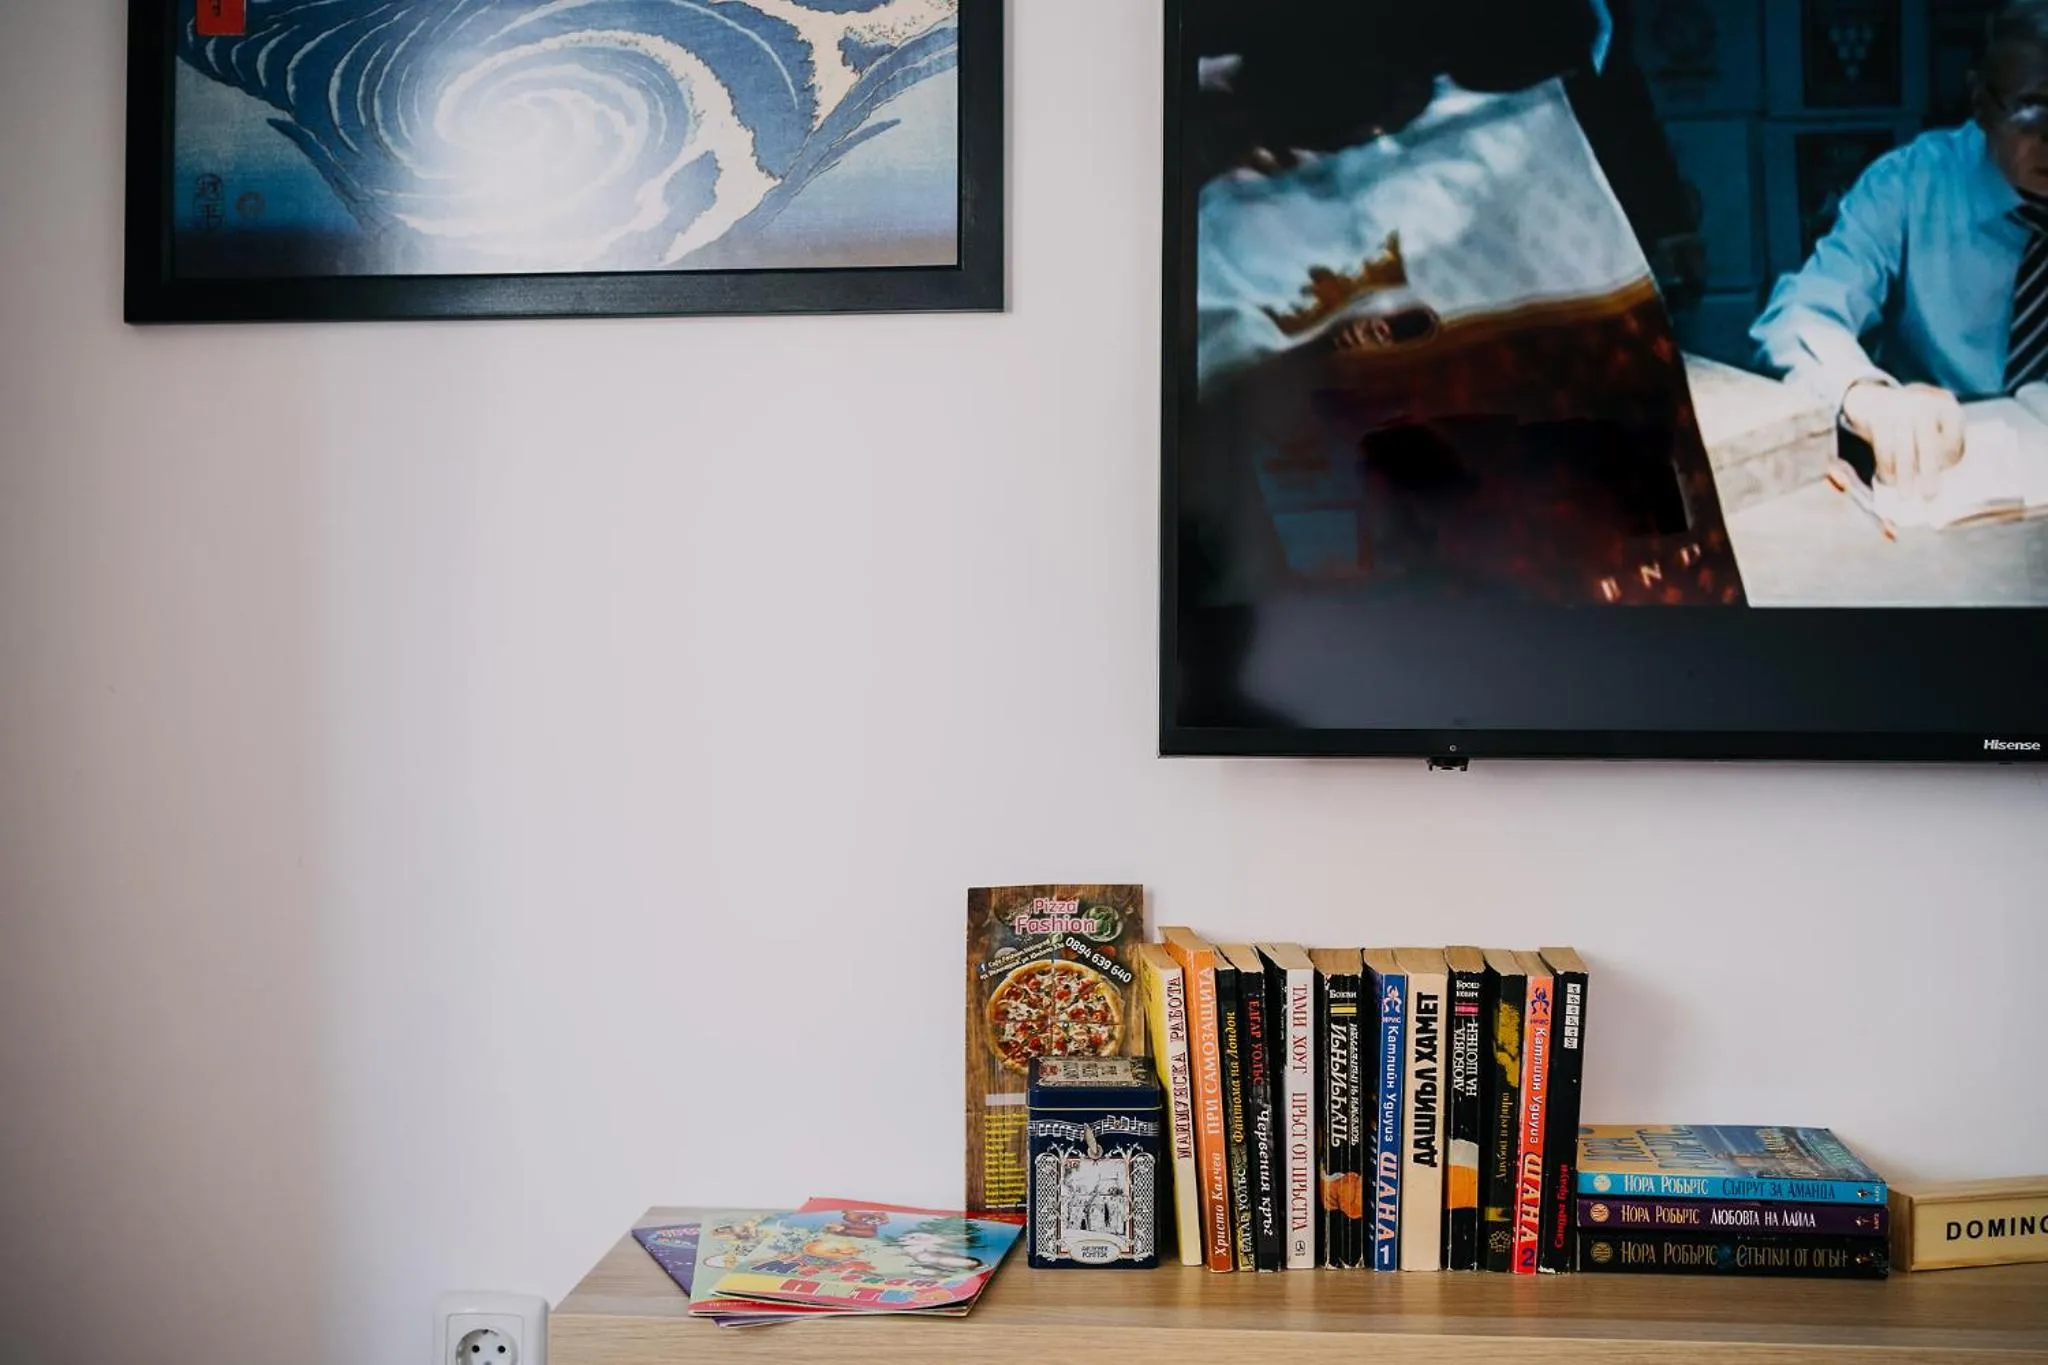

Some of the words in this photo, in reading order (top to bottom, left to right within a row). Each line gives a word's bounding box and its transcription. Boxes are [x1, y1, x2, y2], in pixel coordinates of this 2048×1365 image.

[1983, 739, 2041, 750] Hisense
[1015, 914, 1097, 934] Fashion
[1033, 898, 1079, 914] Pizza
[1065, 937, 1092, 958] 0894
[1091, 953, 1112, 970] 639
[1110, 965, 1132, 983] 640
[1167, 976, 1184, 1042] РАБОТА
[1292, 984, 1307, 1027] ТАМИ
[1415, 992, 1439, 1064] ХАМЕТ
[1199, 967, 1218, 1094] САМОЗАЩИТА
[1225, 1011, 1239, 1059] Лондон
[1466, 1022, 1478, 1075] ШОПЕН
[1229, 1065, 1240, 1078] на
[1292, 1035, 1308, 1078] ХОУГ
[1387, 1025, 1399, 1088] Катлийн
[1453, 1026, 1465, 1092] ЛЮБОВТА
[1532, 1027, 1547, 1091] Катлийн
[1330, 1023, 1347, 1147] ПУЧИНИ
[1465, 1077, 1478, 1096] НА
[1206, 1096, 1220, 1134] ПРИ
[1231, 1082, 1245, 1143] Фантома
[1384, 1093, 1397, 1142] Удиуиз
[1413, 1068, 1438, 1168] ДАШИЪЛ
[1529, 1095, 1542, 1144] Удиуиз
[1254, 1109, 1271, 1192] Червения
[1292, 1143, 1307, 1163] ОТ
[1377, 1151, 1397, 1241] ШАНА
[1520, 1152, 1541, 1242] ШАНА
[1624, 1175, 1655, 1193] НОРА
[1661, 1175, 1709, 1195] РОБЪРТС
[1722, 1177, 1764, 1196] СЪПРУГ
[1771, 1182, 1782, 1197] ЗА
[1787, 1182, 1835, 1200] АМАНДА
[1215, 1205, 1229, 1256] Христо
[1240, 1215, 1252, 1253] ЕДГАР
[1258, 1197, 1274, 1236] кръг
[1621, 1204, 1650, 1223] НОРА
[1655, 1205, 1700, 1224] РОБЪРТС
[1710, 1208, 1760, 1226] ЛЮБОВТА
[1764, 1211, 1778, 1226] НА
[1782, 1209, 1816, 1228] ЛАЙЛА
[1380, 1244, 1389, 1265] 1
[1522, 1248, 1536, 1266] 2
[1621, 1241, 1656, 1264] НОРА
[1663, 1242, 1718, 1265] РОБЪРТС
[1794, 1249, 1809, 1266] ОТ
